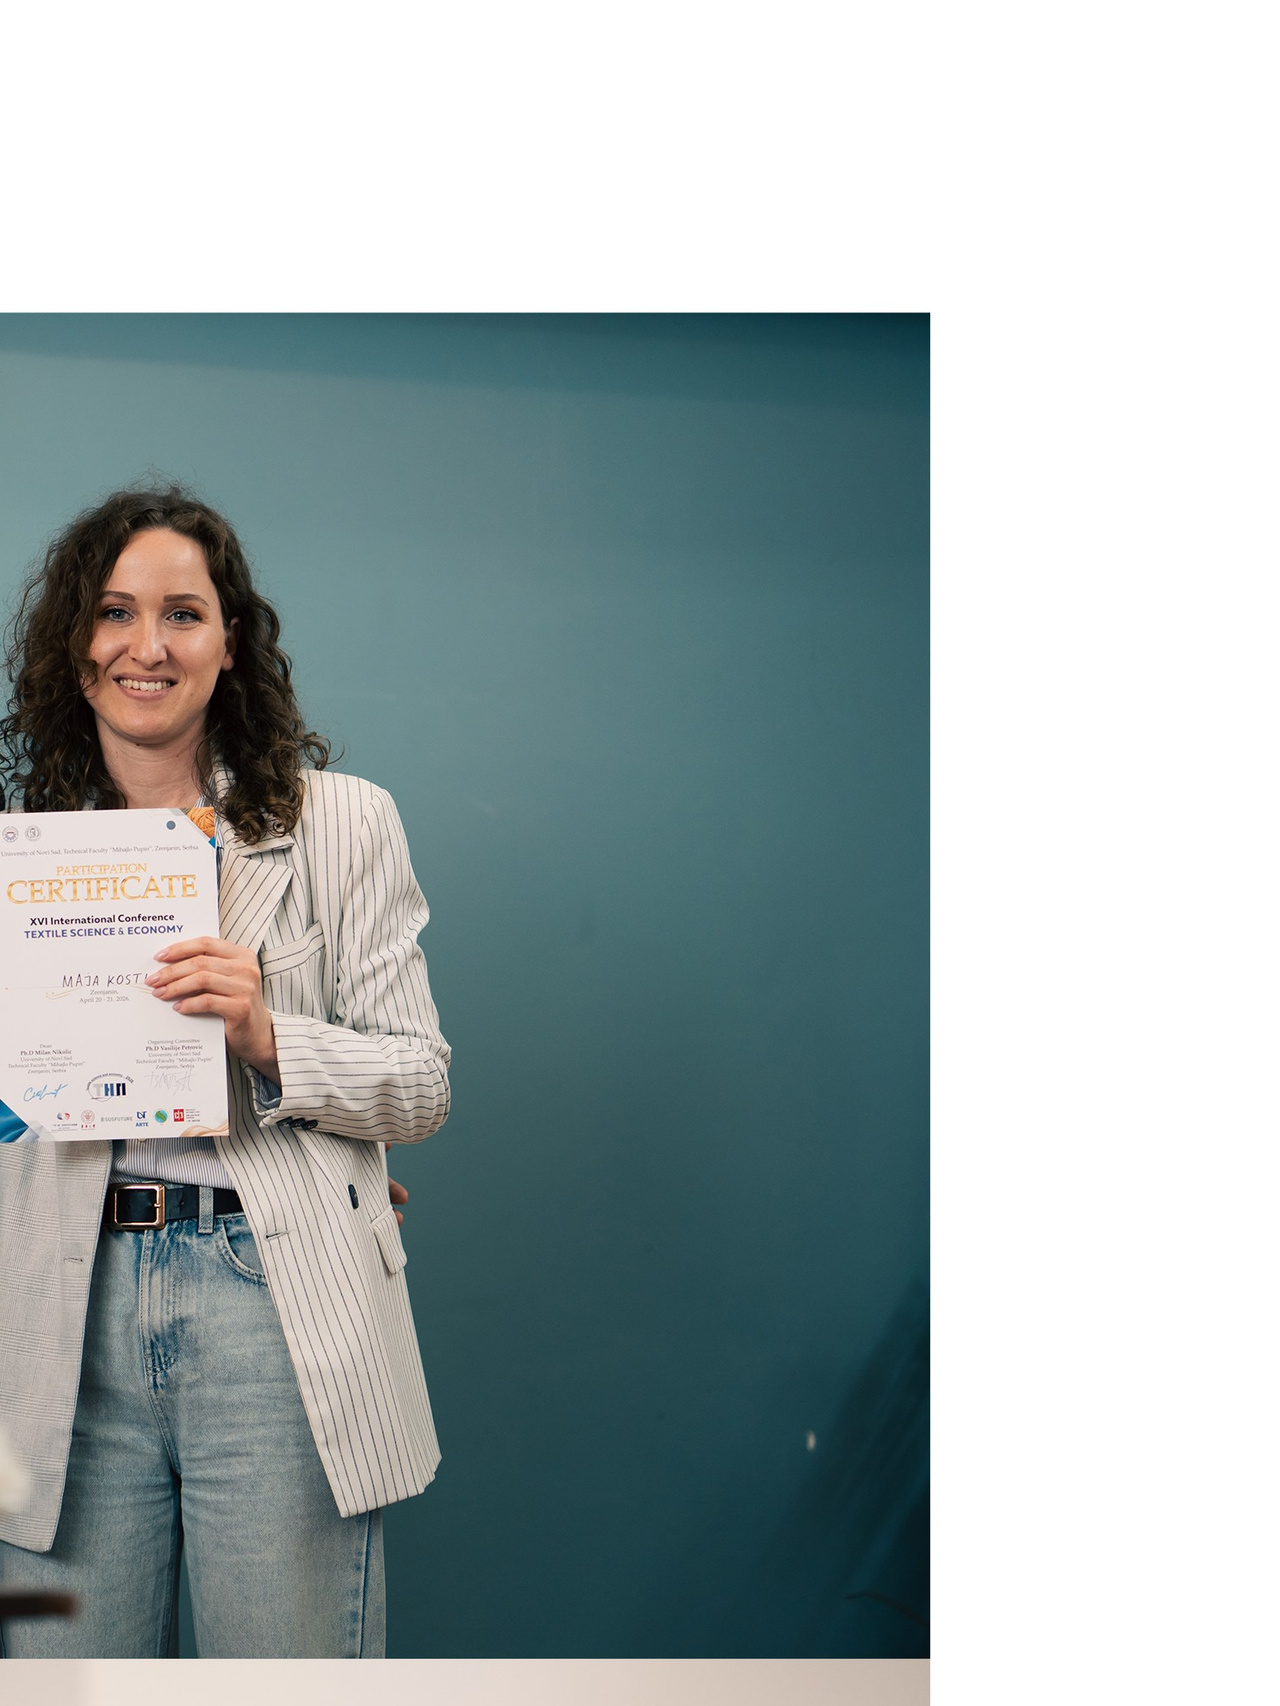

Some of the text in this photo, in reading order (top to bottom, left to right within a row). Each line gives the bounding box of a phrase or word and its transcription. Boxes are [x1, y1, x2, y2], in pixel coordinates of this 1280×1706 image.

[56, 863, 148, 876] PARTICIPATION
[6, 874, 198, 904] CERTIFICATE
[30, 913, 175, 926] XVI International Conference
[24, 925, 184, 939] TEXTILE SCIENCE & ECONOMY
[62, 973, 100, 988] MAJA
